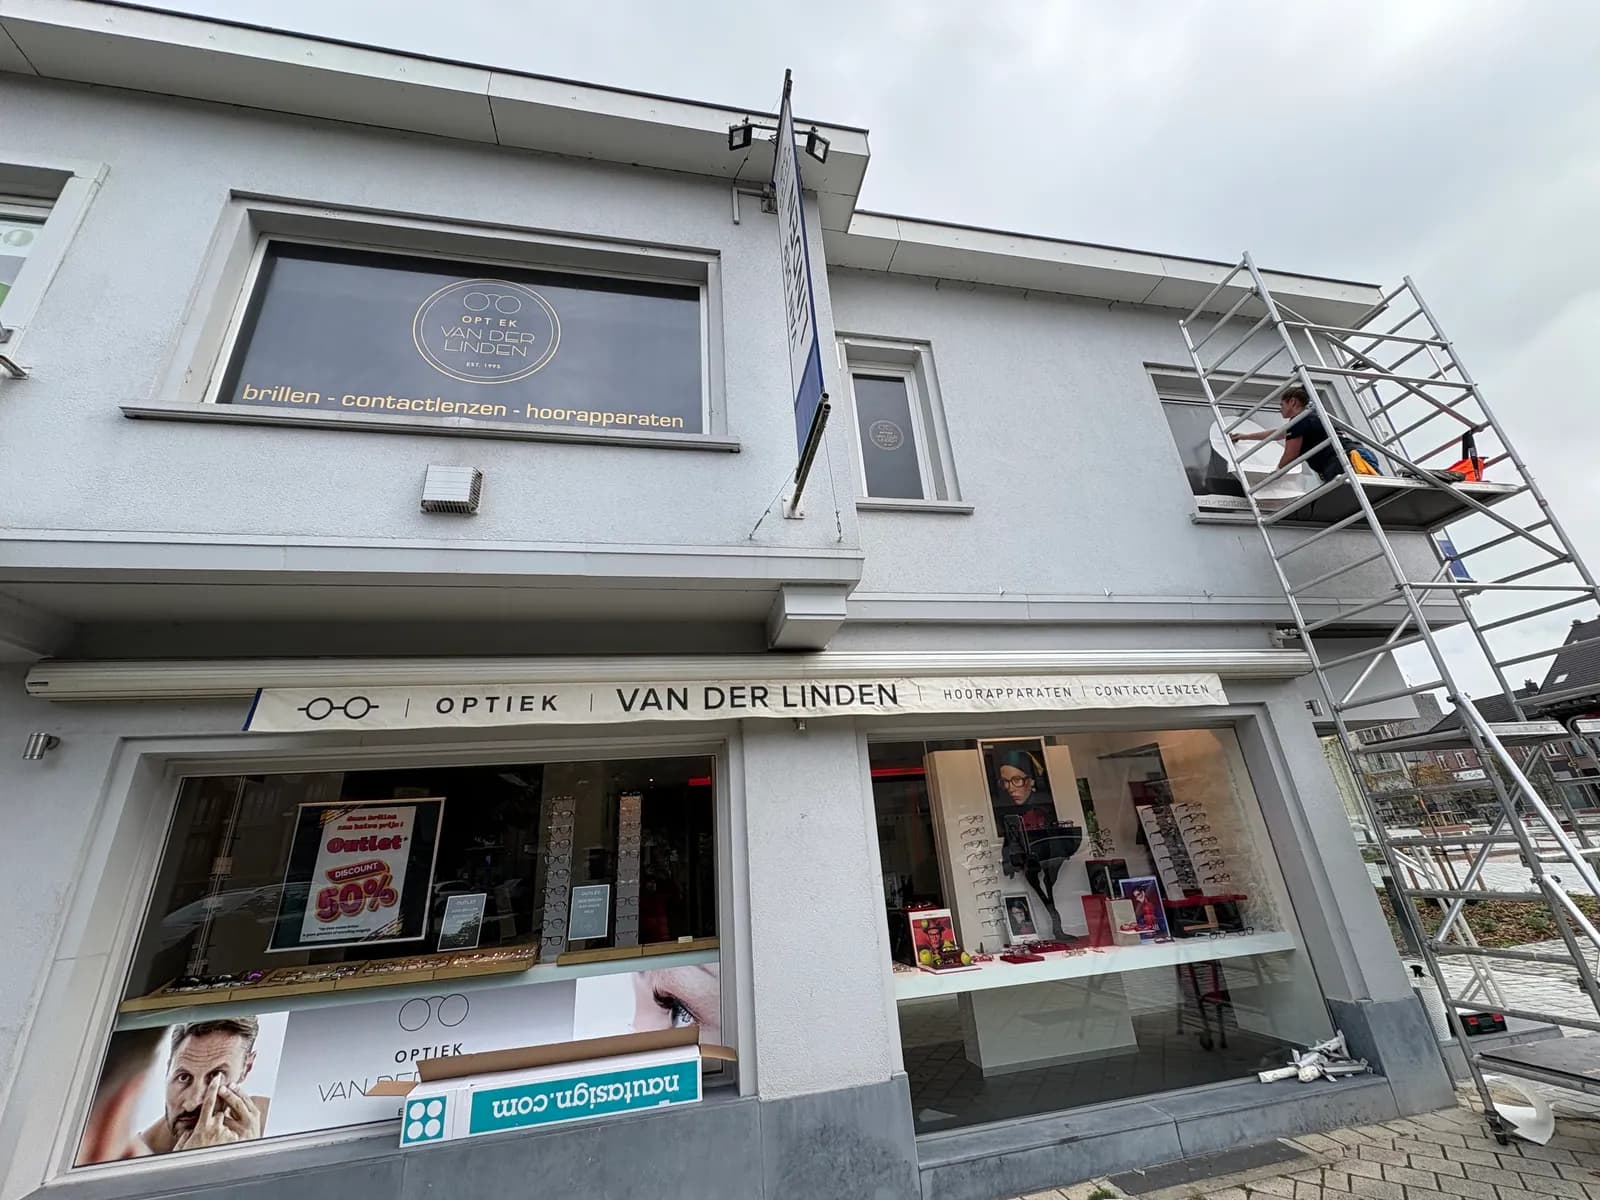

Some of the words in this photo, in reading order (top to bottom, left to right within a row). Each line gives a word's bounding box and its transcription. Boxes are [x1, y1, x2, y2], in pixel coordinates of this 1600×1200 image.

[462, 315, 517, 328] OPTEK
[440, 325, 482, 340] VAN
[489, 329, 536, 345] DER
[444, 339, 528, 357] LINDEN
[242, 384, 320, 404] brillen
[342, 394, 507, 417] contactlenzen
[526, 403, 684, 428] hoorapparaten
[616, 686, 688, 713] VAN
[704, 684, 769, 710] DER
[782, 683, 898, 707] LINDEN
[943, 687, 1072, 700] HOORAPPARATEN
[1094, 683, 1210, 697] CONTACTLENZEN
[435, 694, 558, 715] OPTIEK
[335, 862, 378, 879] DISCOUNT
[316, 876, 398, 921] 50%
[394, 1042, 463, 1063] OPTIEK
[318, 1078, 368, 1103] VAN
[492, 1074, 680, 1118] nautasign.com
